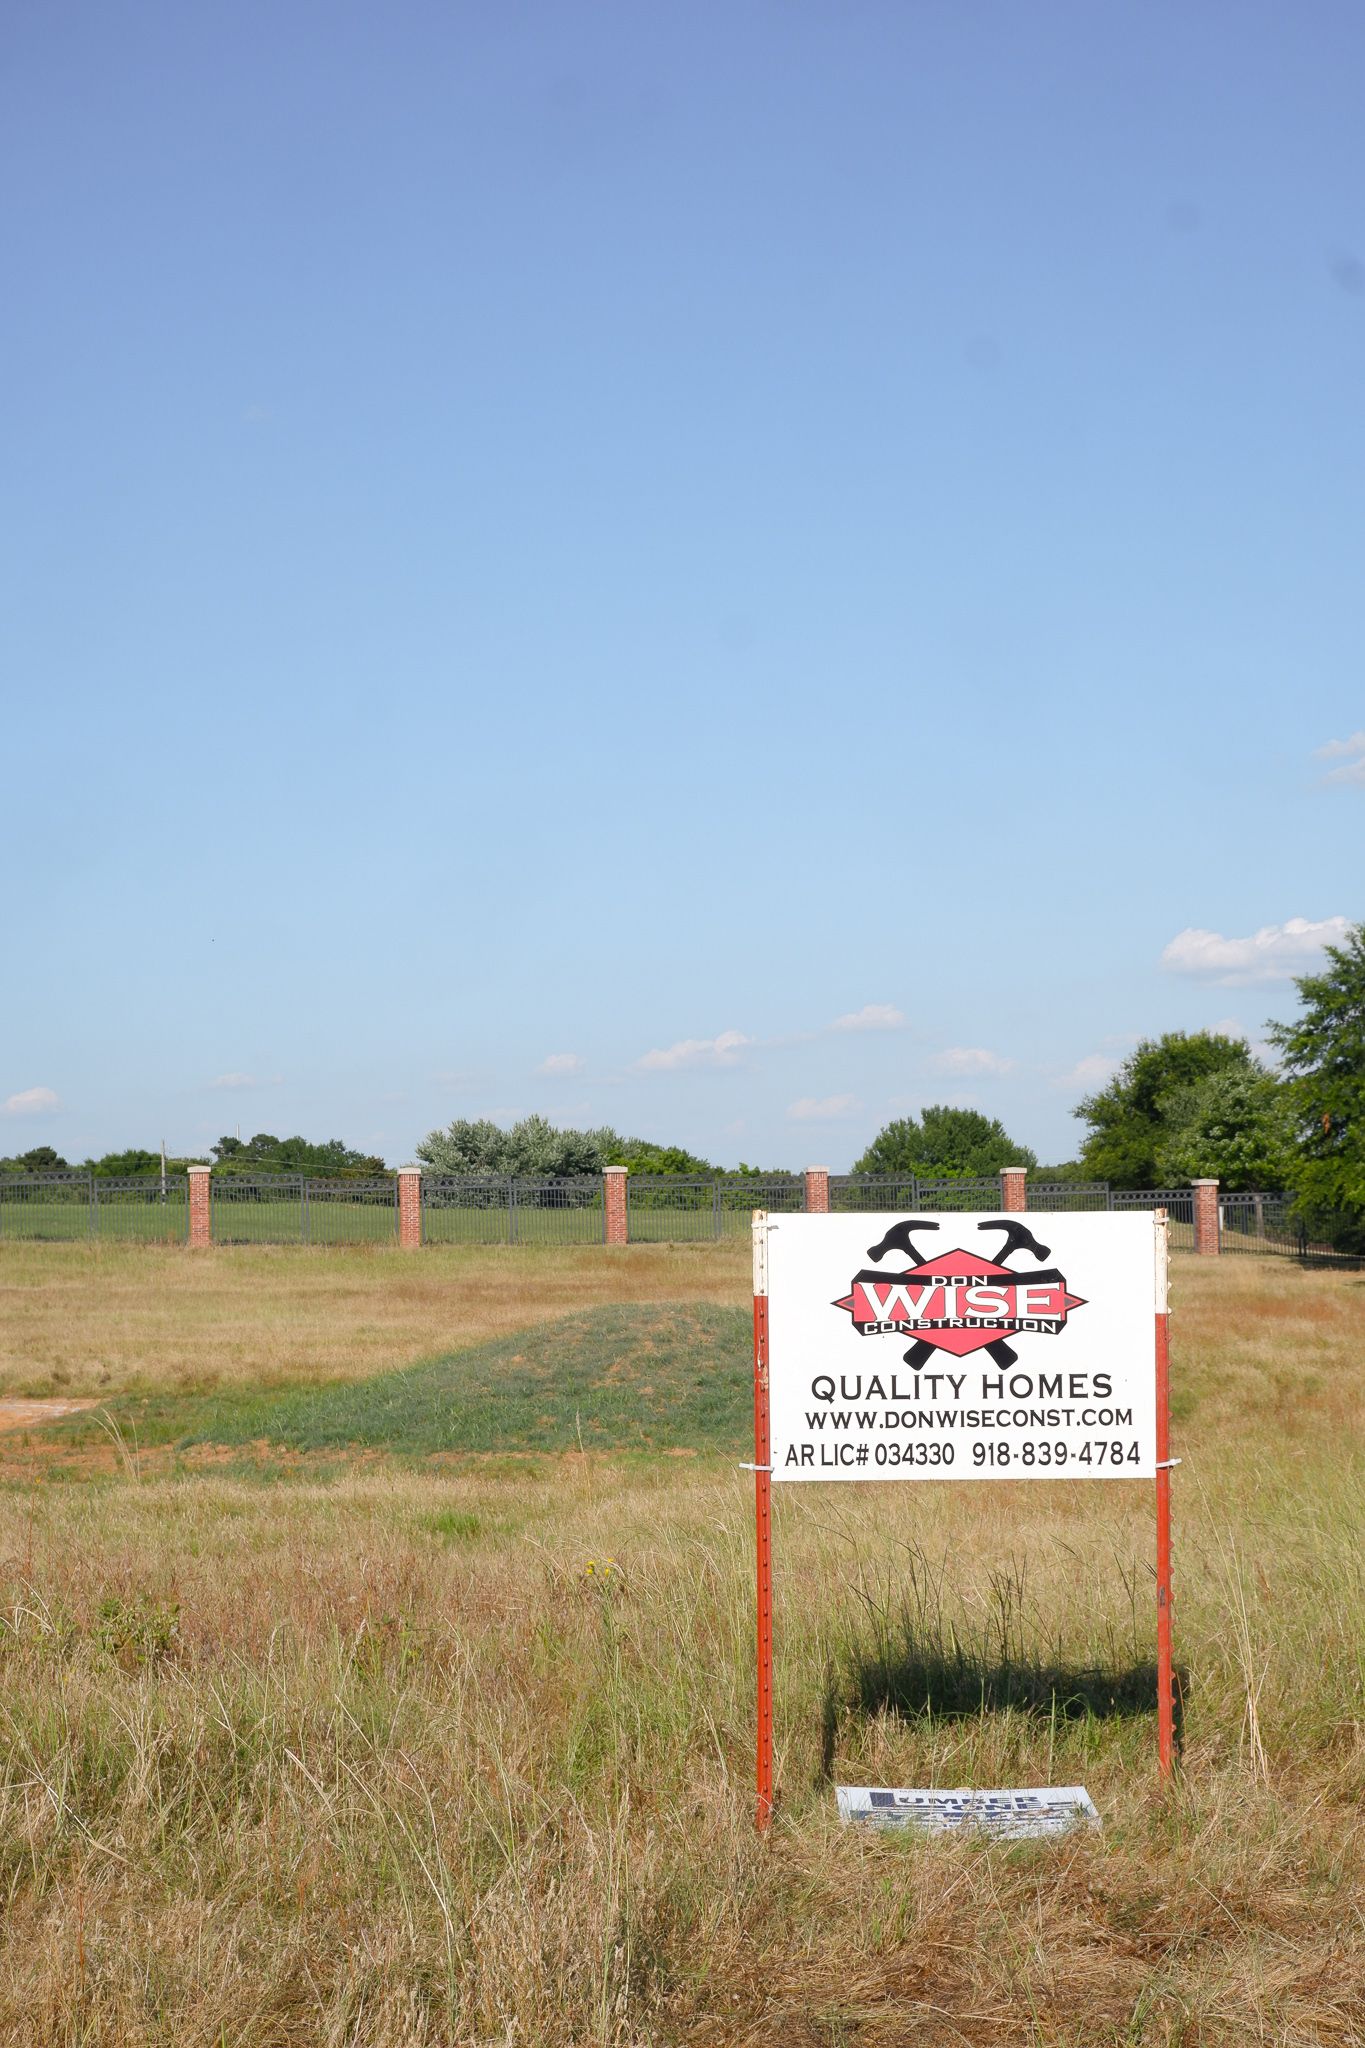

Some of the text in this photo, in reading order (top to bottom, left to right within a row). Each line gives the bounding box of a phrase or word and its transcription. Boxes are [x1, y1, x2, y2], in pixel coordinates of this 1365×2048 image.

[932, 1275, 988, 1287] DON
[858, 1281, 1062, 1321] WISE
[864, 1318, 1057, 1335] CONSTRUCTION
[812, 1374, 1112, 1404] QUALITY HOMES
[805, 1409, 1132, 1429] WWW.DONWISECONST.COM
[785, 1441, 1140, 1466] AR LIC# 034330 918-839-4784
